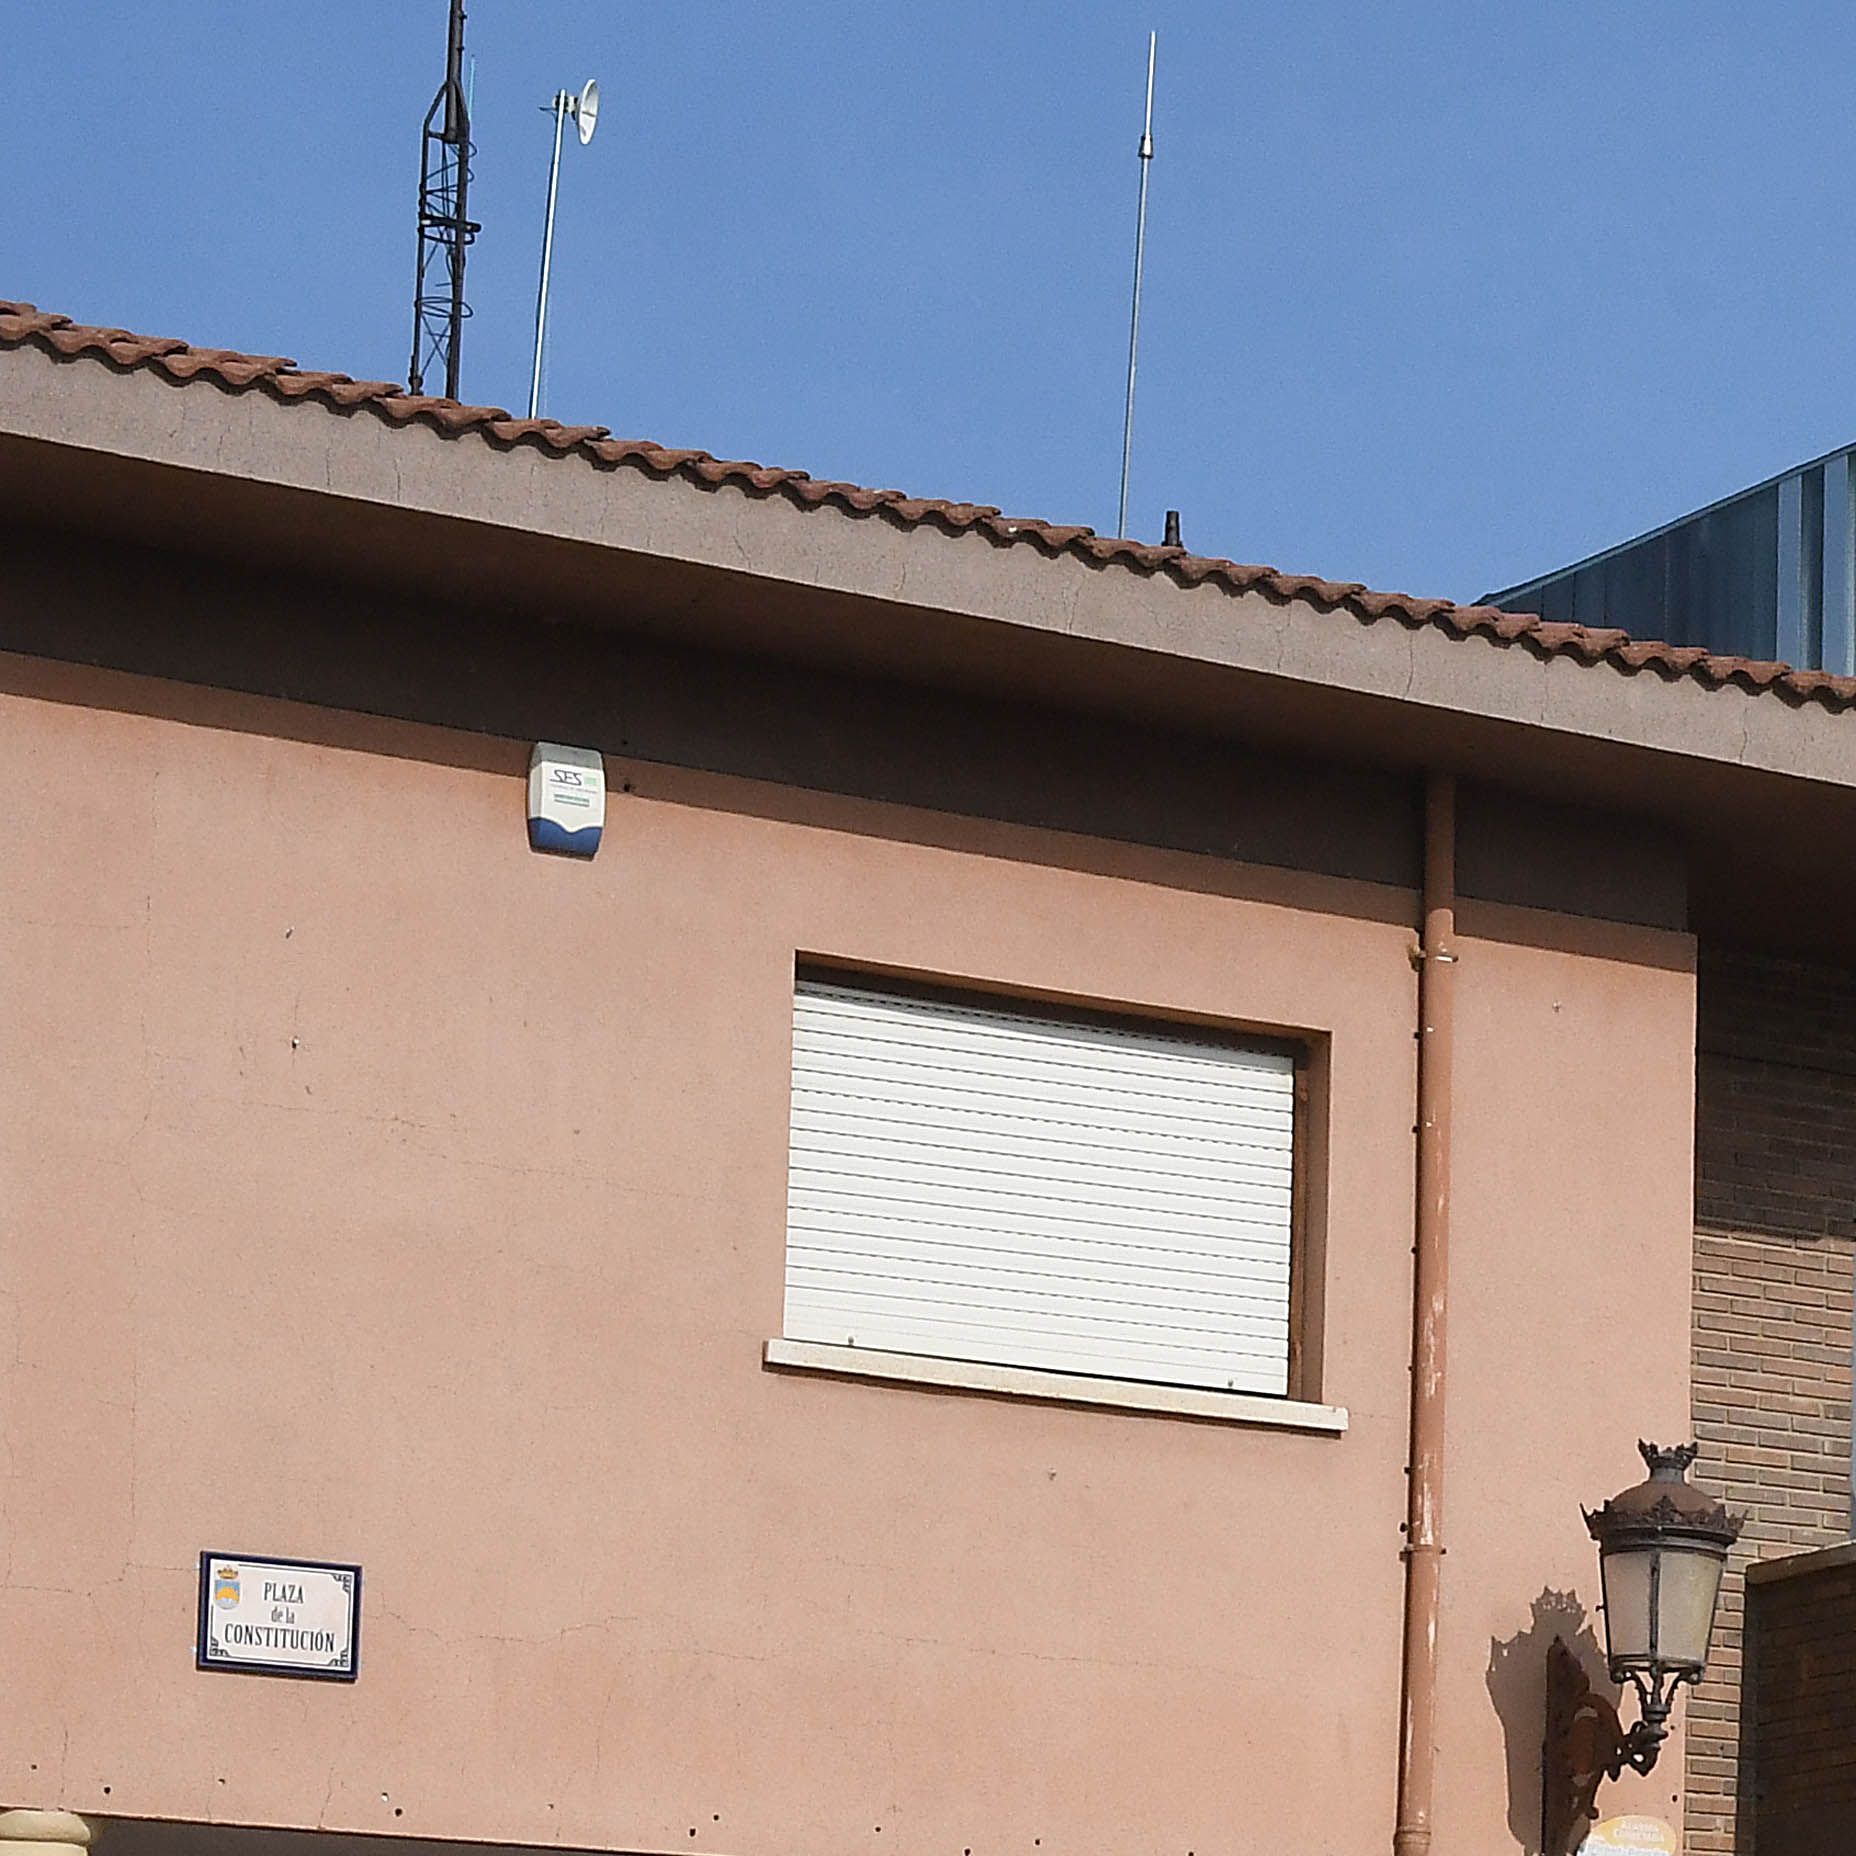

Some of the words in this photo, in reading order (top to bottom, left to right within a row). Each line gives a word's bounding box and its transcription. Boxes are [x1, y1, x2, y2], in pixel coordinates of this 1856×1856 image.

[549, 769, 583, 786] SES
[263, 1581, 305, 1604] PLAZA
[271, 1606, 283, 1623] de
[286, 1607, 295, 1624] la
[224, 1623, 336, 1653] CONSTITUCIÓN
